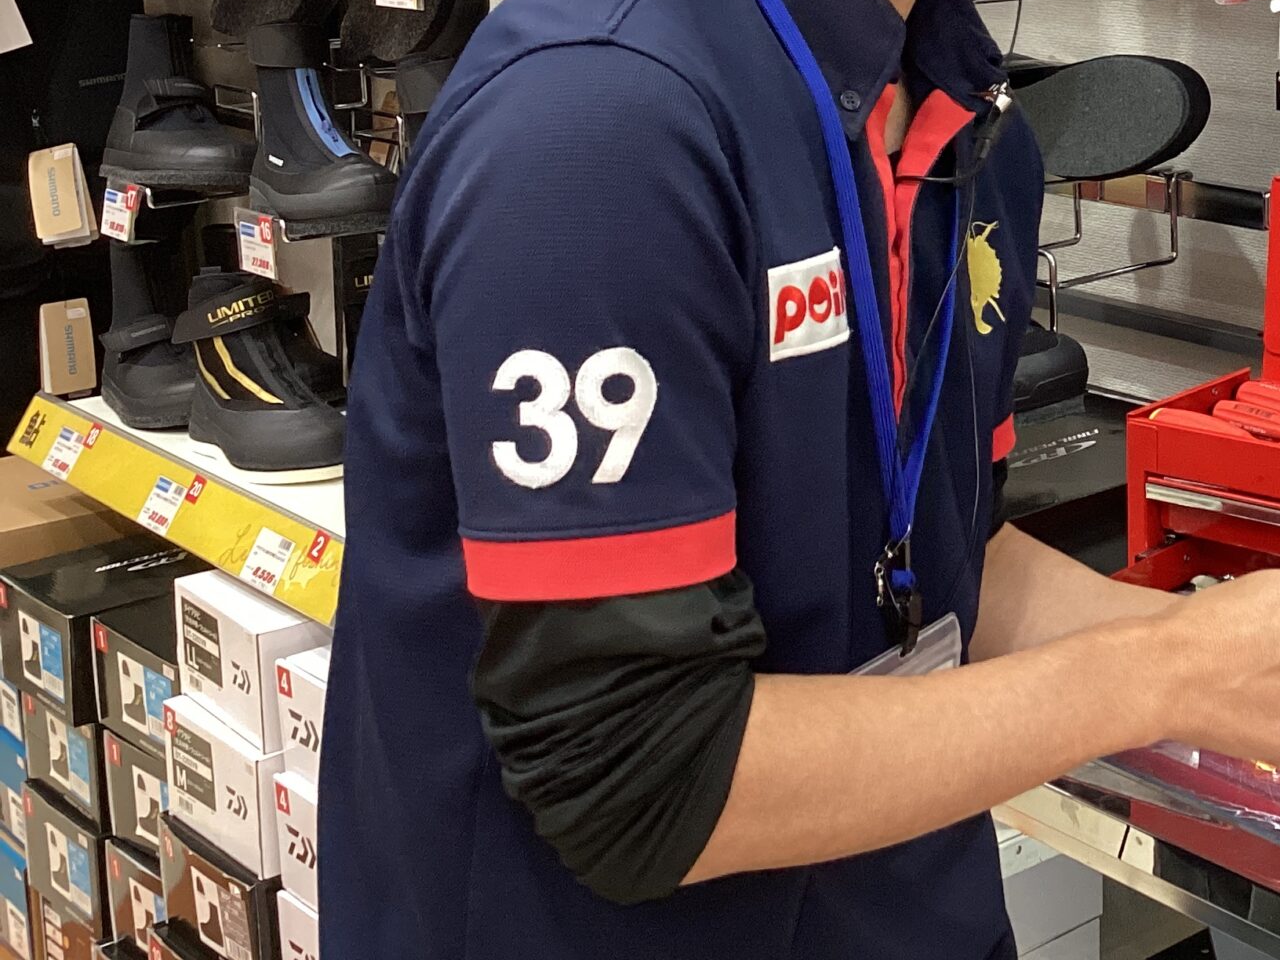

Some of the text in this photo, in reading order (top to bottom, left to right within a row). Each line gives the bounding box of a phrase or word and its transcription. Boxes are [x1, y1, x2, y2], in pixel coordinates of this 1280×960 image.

[47, 165, 62, 218] SHIMANO
[125, 189, 136, 207] 17
[259, 220, 271, 241] 16
[206, 289, 276, 324] LIMITED
[66, 323, 78, 376] SHIMANO
[491, 346, 658, 490] 39
[87, 426, 99, 446] 18
[190, 478, 203, 498] 20
[312, 534, 325, 559] 2
[186, 642, 200, 670] LL
[279, 676, 291, 694] 4
[175, 765, 188, 791] M
[279, 792, 290, 811] 4
